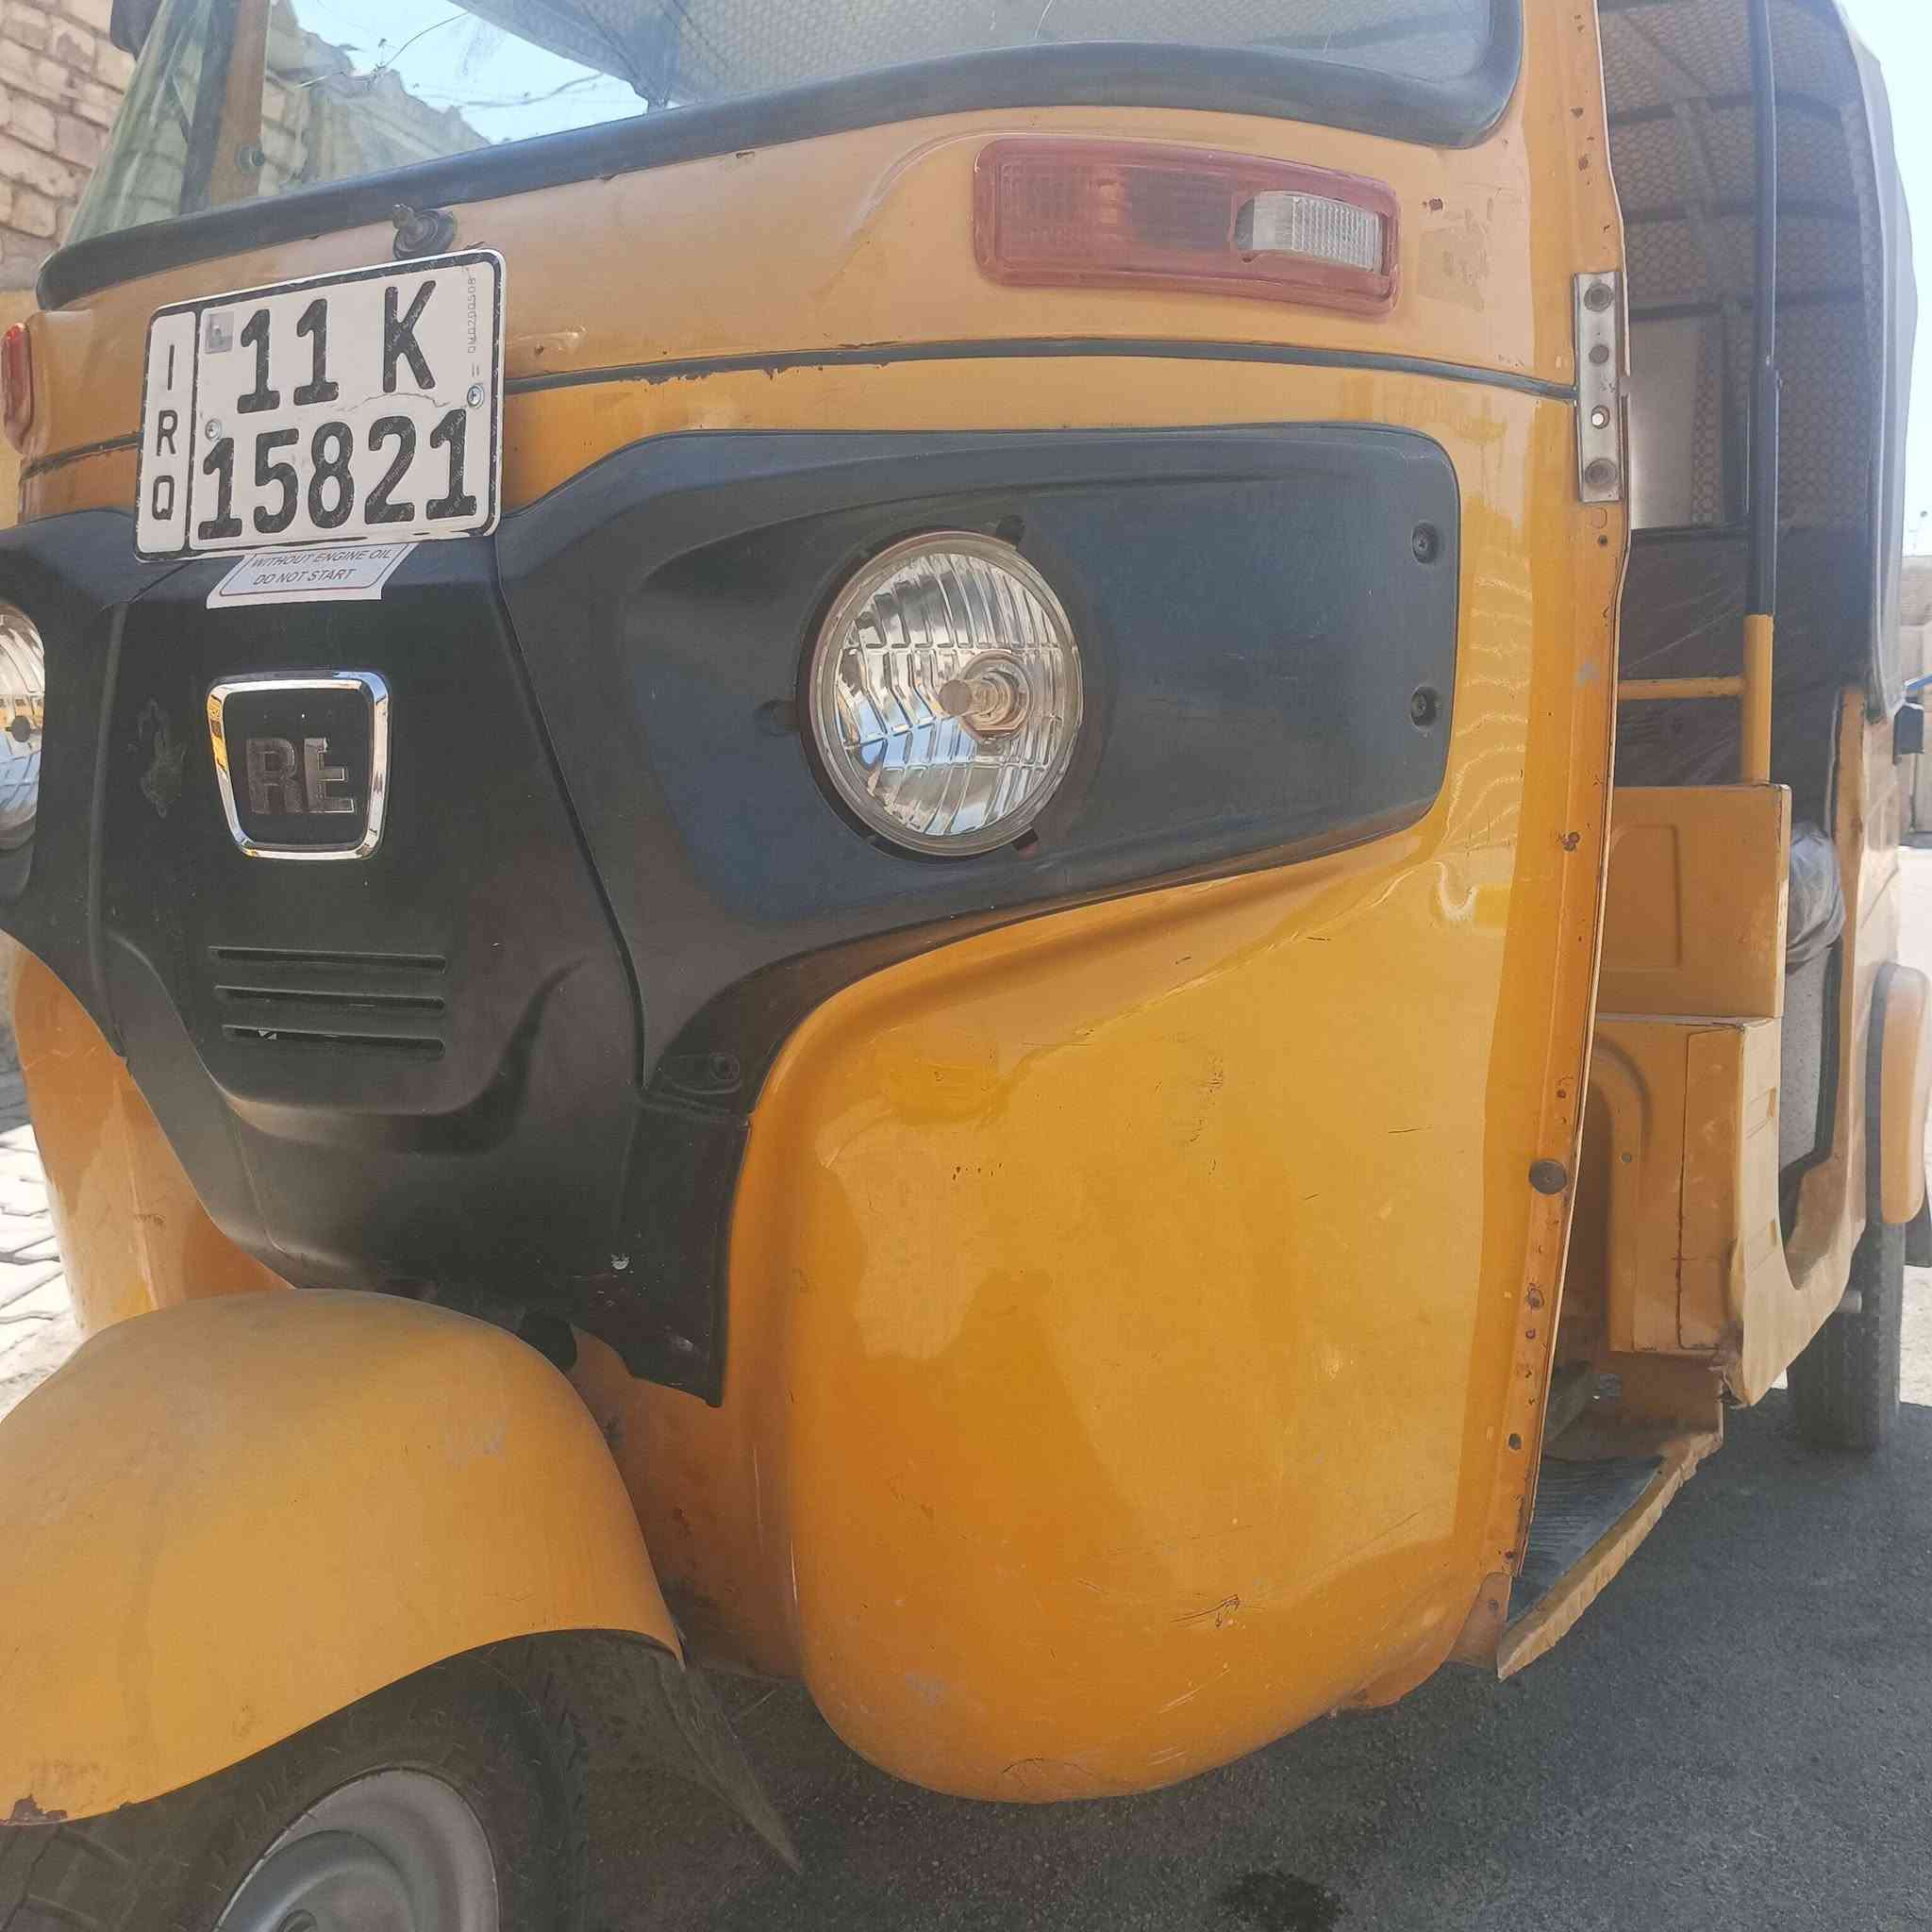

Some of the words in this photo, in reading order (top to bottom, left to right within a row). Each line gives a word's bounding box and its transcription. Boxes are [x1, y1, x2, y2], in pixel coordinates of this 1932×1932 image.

[236, 298, 340, 415] 11
[381, 279, 438, 394] K
[151, 343, 179, 521] IRQ
[196, 408, 477, 541] 15821
[253, 552, 315, 568] WITHOUT
[314, 549, 370, 562] ENGINE
[369, 548, 393, 560] OIL
[253, 574, 278, 586] DO
[277, 571, 308, 584] NOT
[307, 568, 358, 582] START
[246, 737, 356, 814] RE
